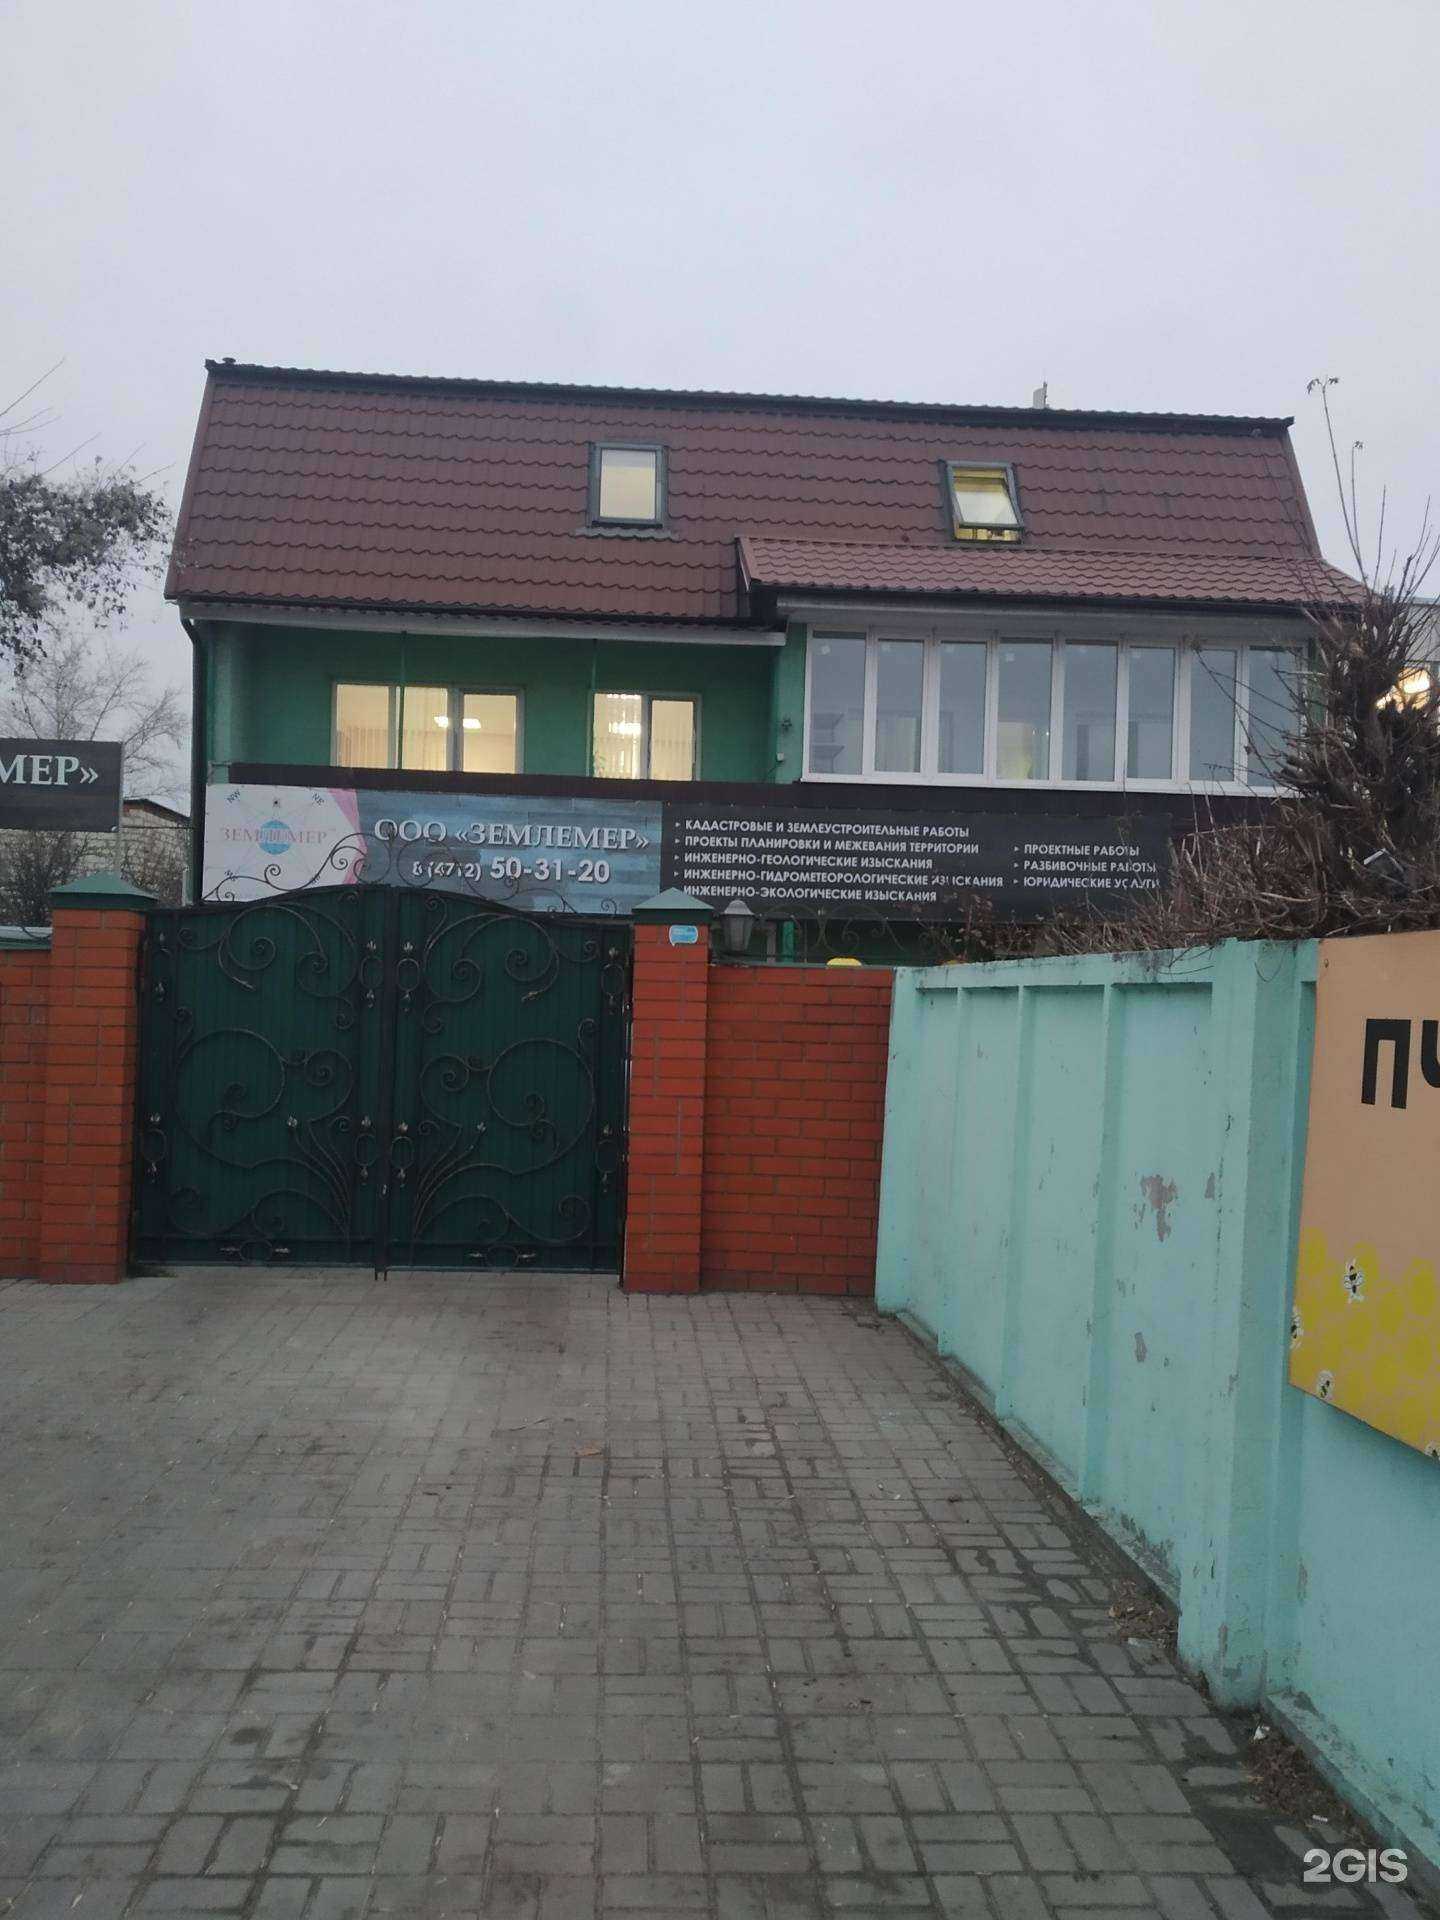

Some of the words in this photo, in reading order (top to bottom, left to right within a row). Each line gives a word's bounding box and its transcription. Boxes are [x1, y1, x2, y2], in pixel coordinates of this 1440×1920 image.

[374, 818, 447, 842] ООО
[455, 821, 650, 850] «ЗЕМЛЕМЕР»
[685, 819, 773, 832] КАДАСТРОВЫЕ
[776, 822, 784, 832] И
[787, 822, 920, 837] ЗЕМЛЕУСТРОИТЕЛЬНЫЕ
[922, 826, 970, 838] РАБОТЫ
[684, 835, 738, 847] ПРОЕКТЫ
[741, 837, 820, 850] ПЛАНИРОВКИ
[823, 840, 832, 850] И
[834, 840, 908, 852] МЕЖЕВАНИЯ
[910, 842, 980, 854] ТЕРРИТОРИИ
[1024, 844, 1091, 856] ПРОЕКТНЫЕ
[1093, 845, 1140, 857] РАБОТЫ
[684, 852, 858, 867] ИНЖЕНЕРНО-ГЕОЛОГИЧЕСКИЕ
[861, 856, 933, 869] ИЗЫСКАНИЯ
[1024, 860, 1107, 873] РАЗБИВОЧНЫЕ
[490, 855, 610, 884] 50-31-20
[683, 868, 928, 885] ИНЖЕНЕРНО-ГИДРОМЕТЕОРОЛОГИЧЕСКИЕ
[1024, 877, 1112, 889] ЮРИДИЧЕСКИЕ
[683, 884, 862, 900] ИНЖЕНЕРНО-ЭКОЛОГИЧЕСКИЕ
[864, 889, 937, 902] ИЗЫСКАНИЯ
